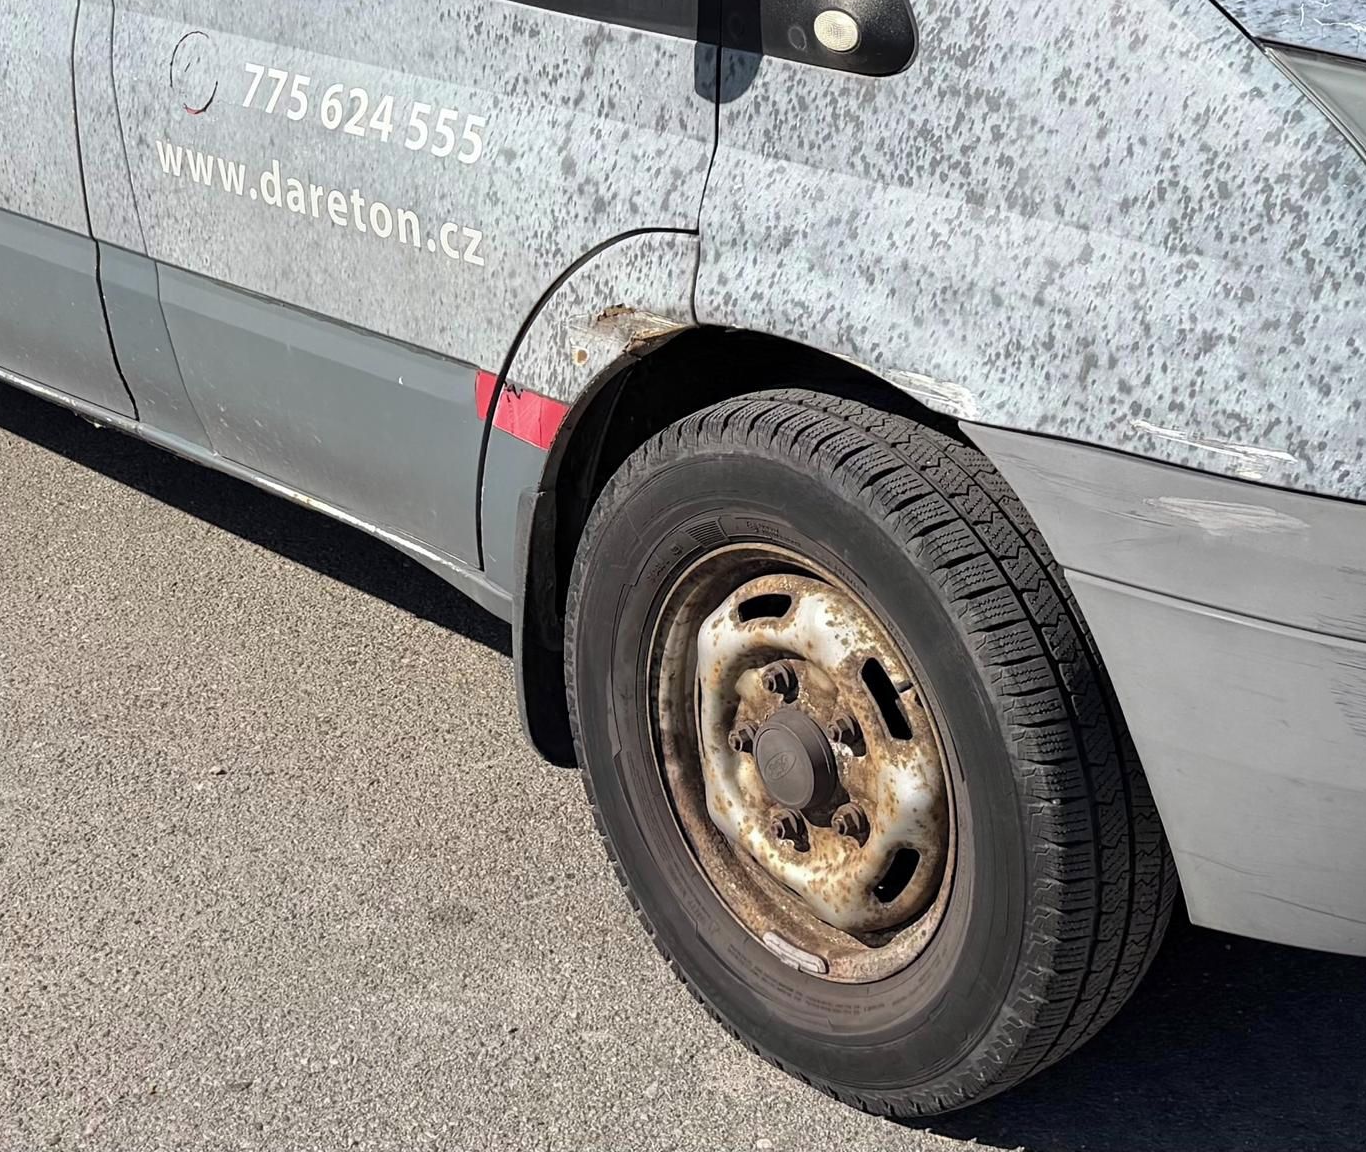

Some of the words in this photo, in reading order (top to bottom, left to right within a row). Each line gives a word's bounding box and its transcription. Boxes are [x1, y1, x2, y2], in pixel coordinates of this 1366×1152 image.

[241, 62, 312, 122] 775
[320, 82, 393, 143] 624
[404, 101, 487, 165] 555
[155, 138, 486, 267] www.dareton.cz
